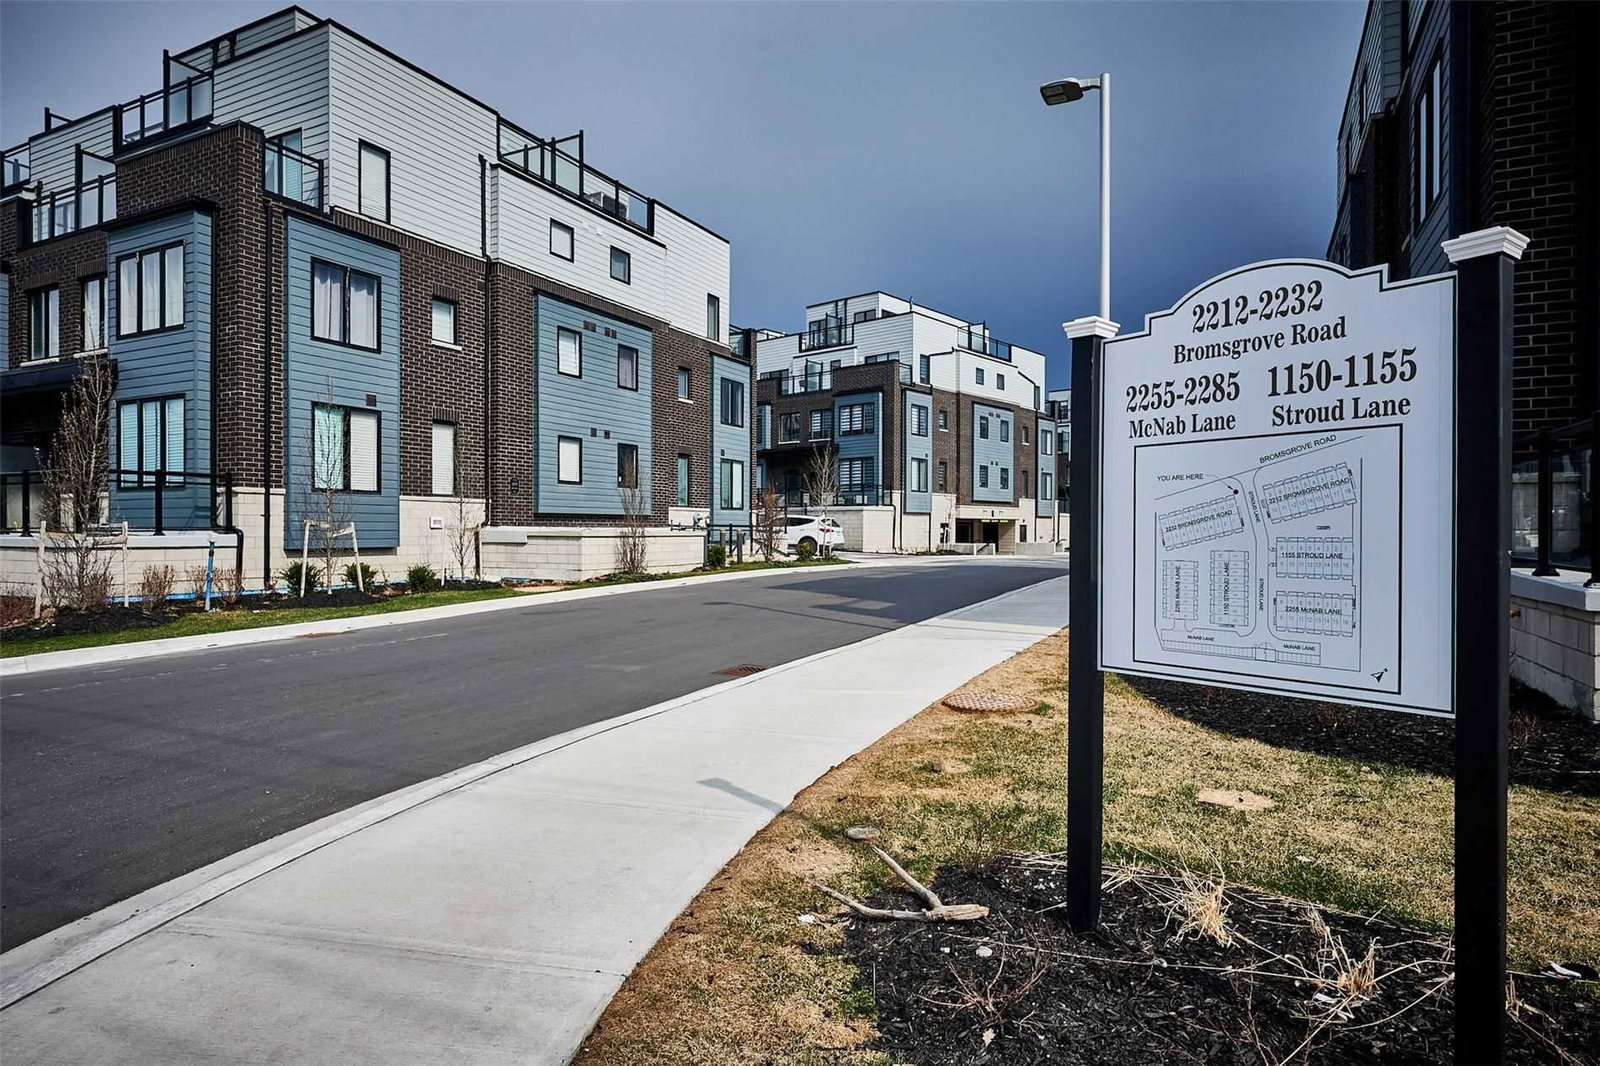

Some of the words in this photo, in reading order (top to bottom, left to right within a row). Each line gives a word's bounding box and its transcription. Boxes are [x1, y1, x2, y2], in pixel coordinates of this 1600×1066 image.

[1192, 280, 1323, 333] 2212-2232
[1173, 332, 1285, 364] Bromsgrove
[1291, 316, 1347, 345] Road
[1267, 346, 1418, 398] 1150-1155
[1125, 370, 1240, 412] 2255-2285
[1128, 416, 1186, 438] McNab
[1191, 413, 1236, 432] Lane
[1272, 399, 1344, 428] Stroud
[1351, 397, 1411, 418] Lane
[1259, 441, 1313, 464] BROMSGROVE
[1314, 434, 1337, 447] ROAD
[1268, 494, 1282, 504] 2212
[1283, 484, 1329, 500] BROMSGROVE
[1330, 477, 1350, 487] ROAD
